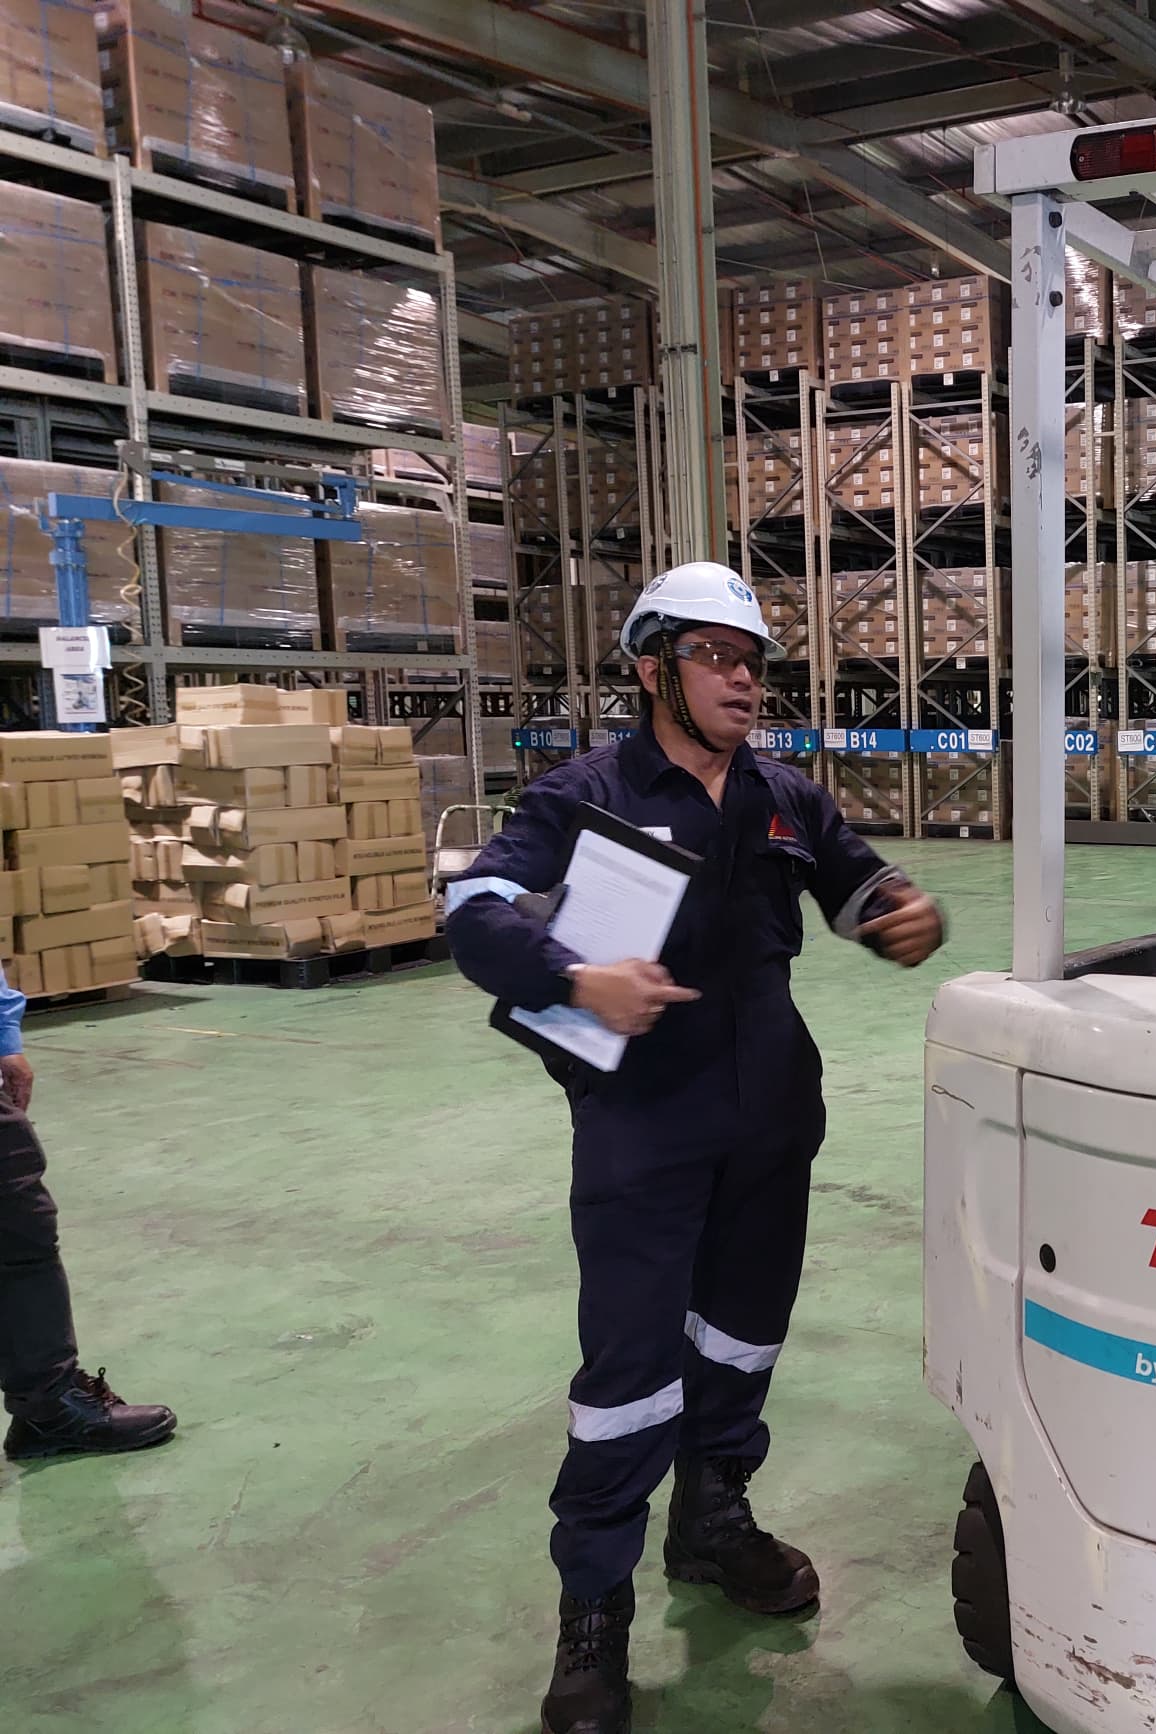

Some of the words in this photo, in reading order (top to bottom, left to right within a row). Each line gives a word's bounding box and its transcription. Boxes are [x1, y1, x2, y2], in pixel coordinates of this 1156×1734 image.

[530, 731, 552, 747] B10
[767, 732, 793, 748] B13
[850, 731, 877, 749] B14
[937, 732, 966, 750] C01
[1064, 733, 1095, 751] C02
